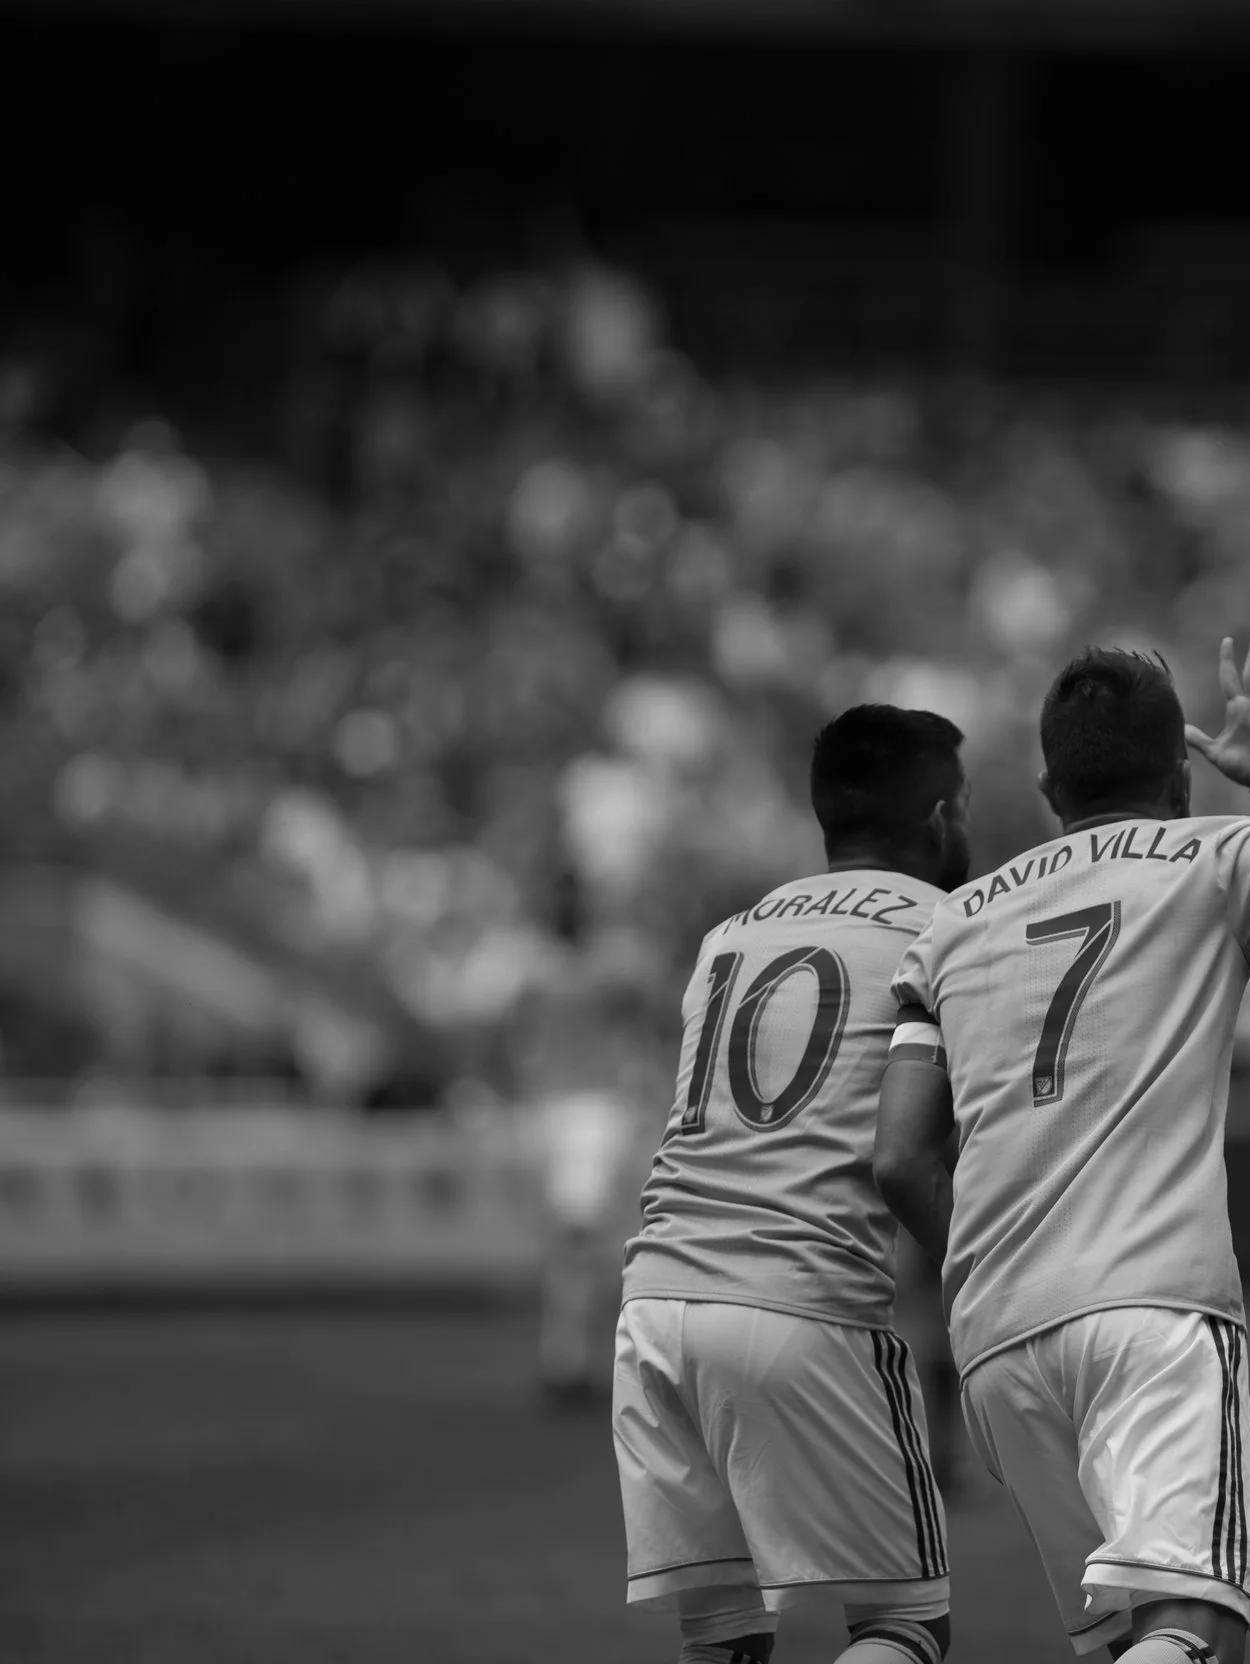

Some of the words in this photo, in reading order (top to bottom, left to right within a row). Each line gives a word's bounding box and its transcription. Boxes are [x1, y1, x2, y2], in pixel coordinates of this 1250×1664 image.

[722, 887, 919, 936] MORALEZ
[962, 844, 1073, 918] DAVID
[1090, 826, 1202, 864] VILLA
[681, 946, 850, 1136] 10
[1025, 900, 1121, 1108] 7
